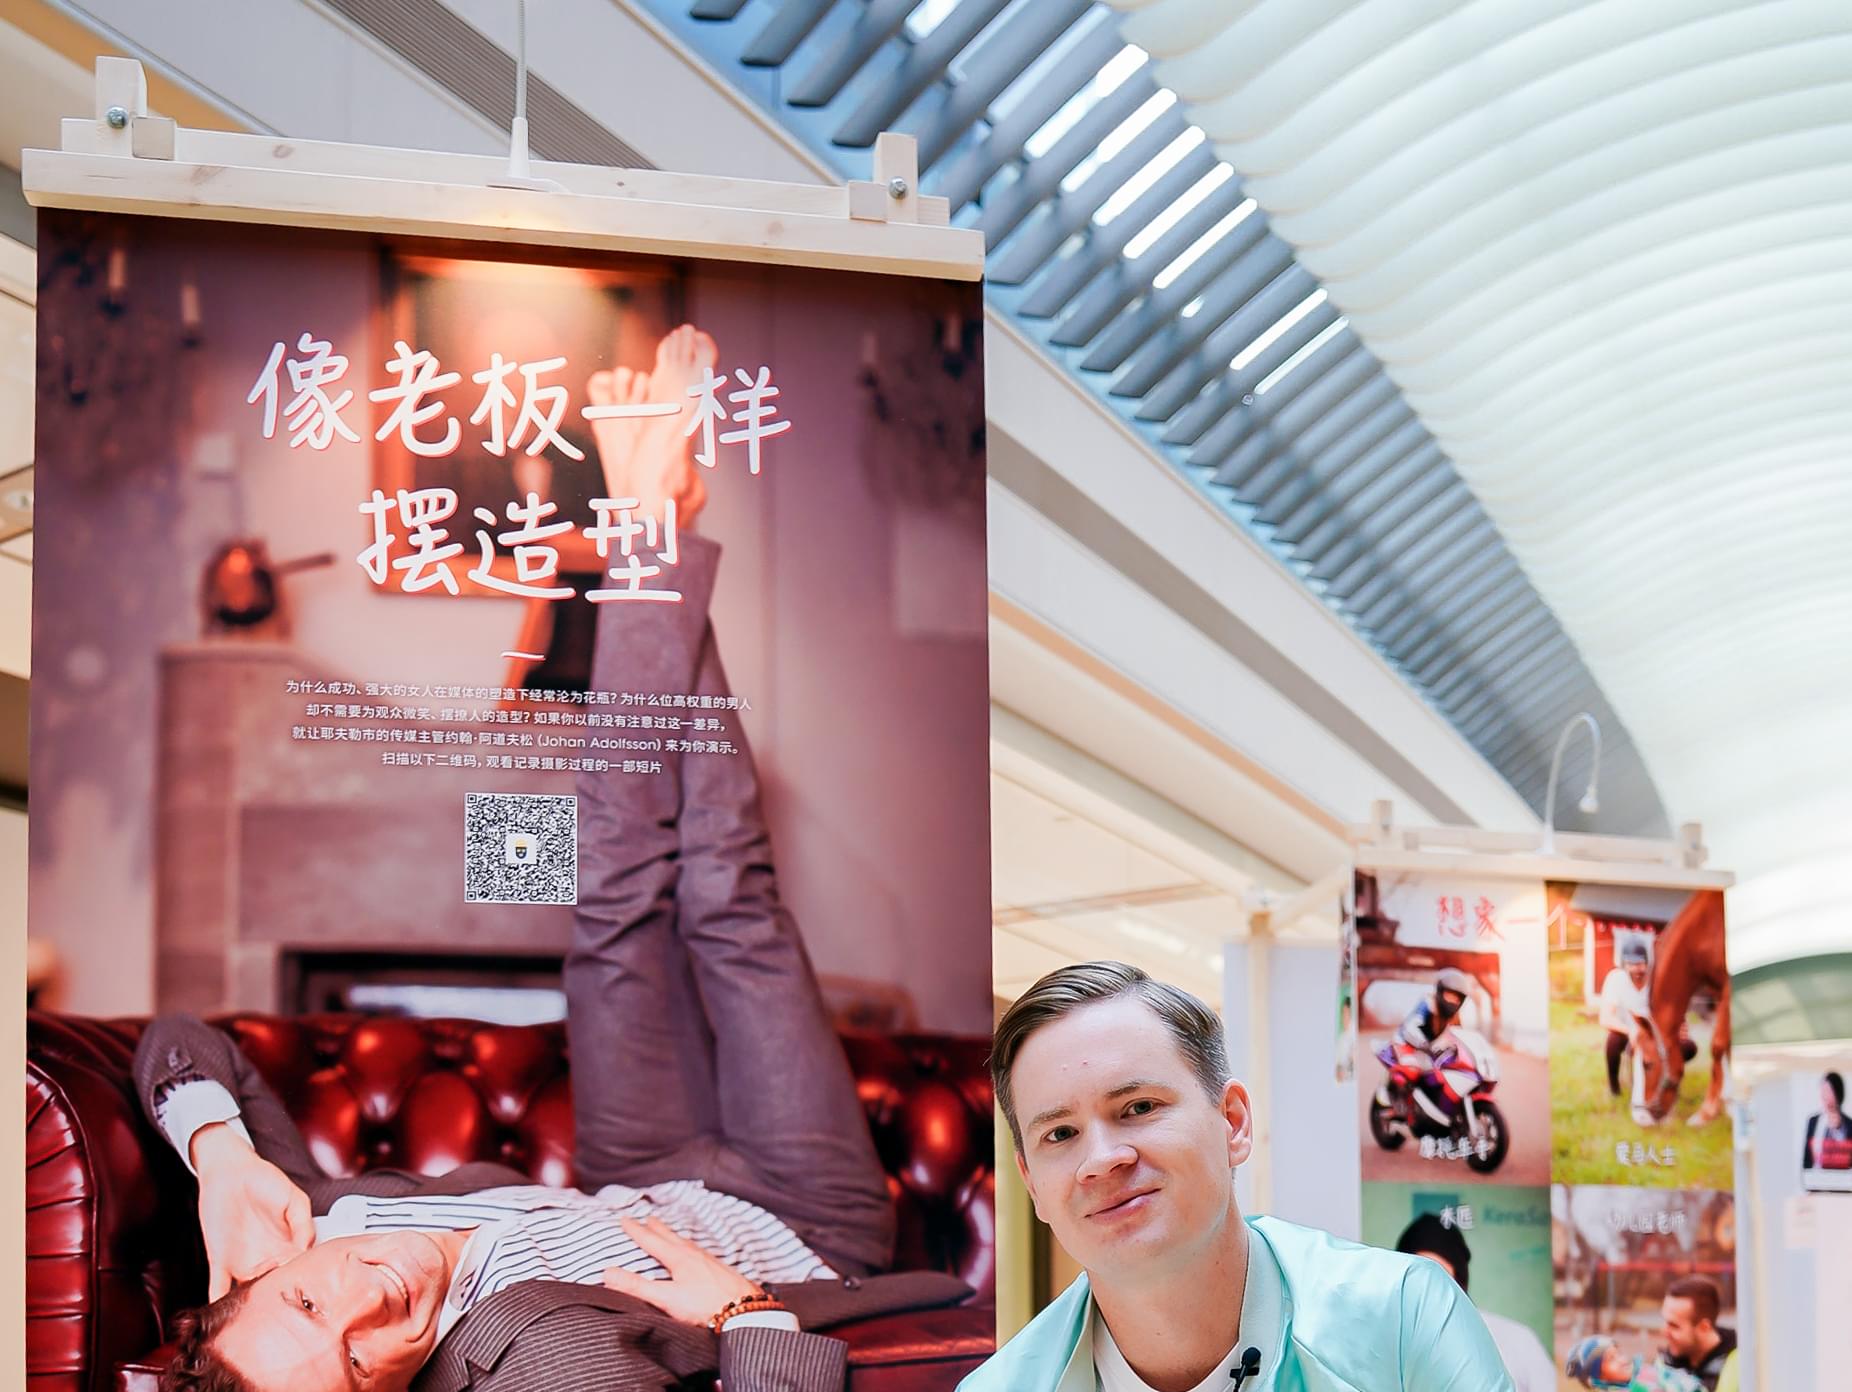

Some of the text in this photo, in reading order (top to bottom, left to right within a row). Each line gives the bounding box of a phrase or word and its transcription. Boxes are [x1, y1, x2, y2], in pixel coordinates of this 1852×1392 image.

[247, 332, 792, 475] 像老板一样
[356, 487, 684, 604] 摆造型
